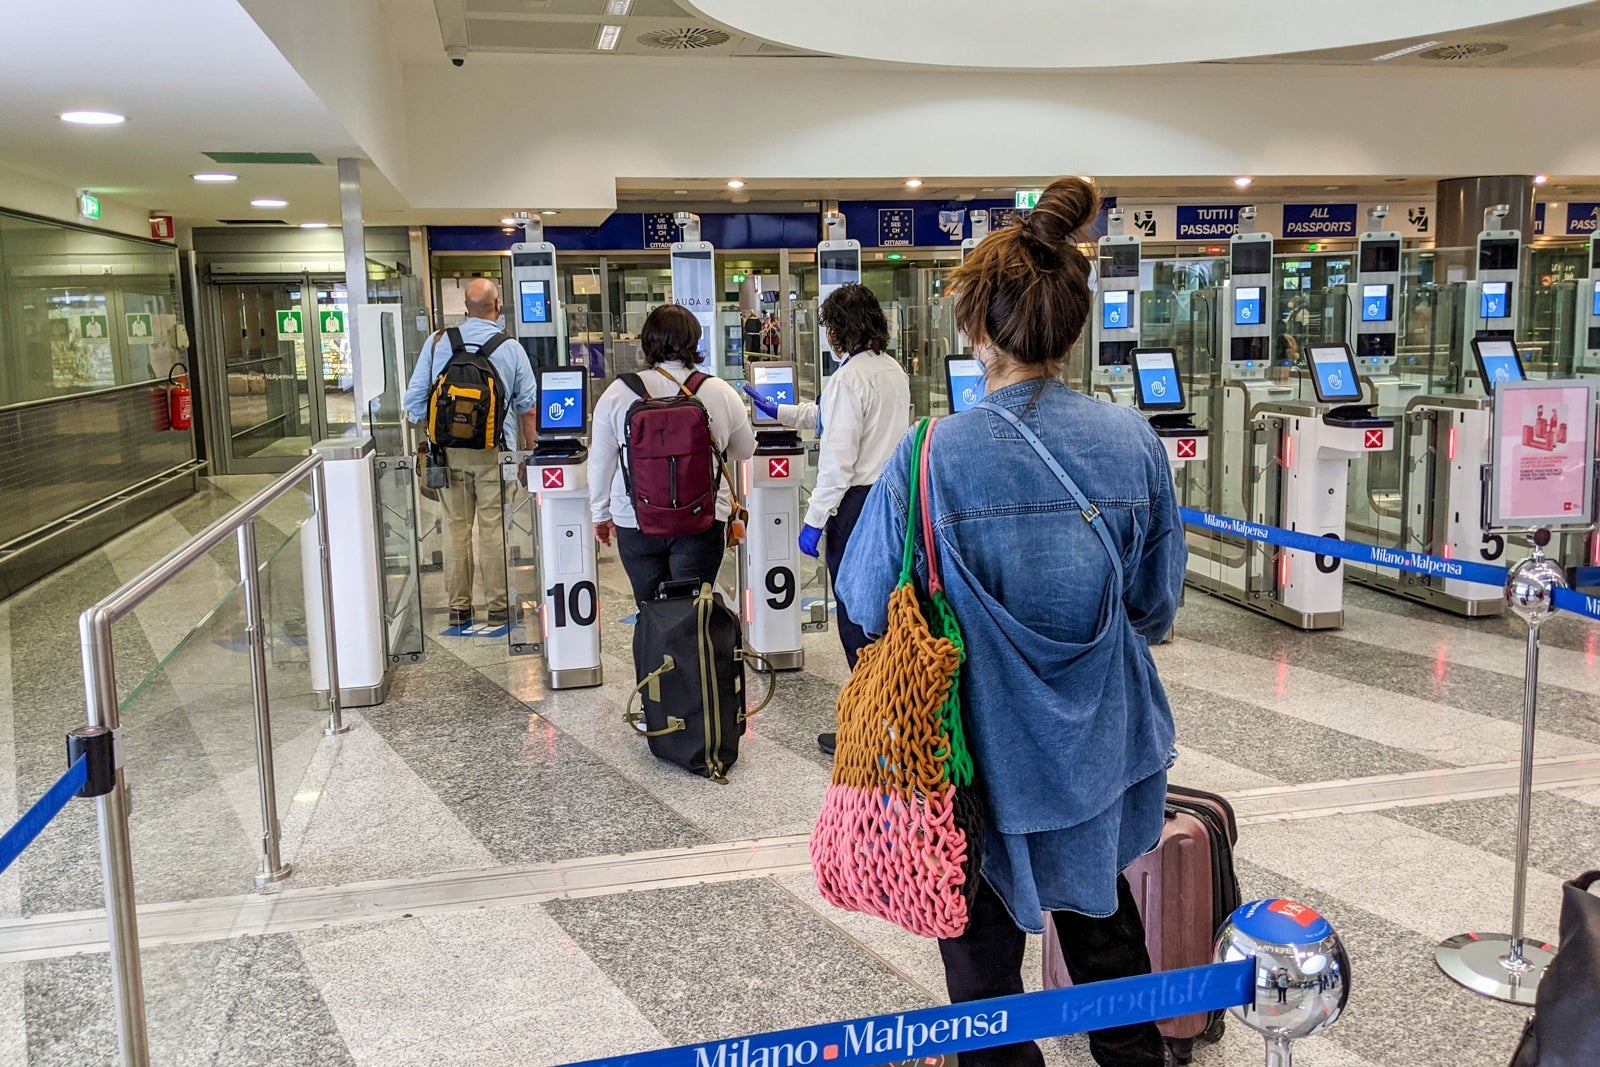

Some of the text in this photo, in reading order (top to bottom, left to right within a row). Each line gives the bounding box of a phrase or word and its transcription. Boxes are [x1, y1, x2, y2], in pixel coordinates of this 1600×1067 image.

[1197, 208, 1233, 220] TUTTI I
[1309, 207, 1330, 218] ALL
[1180, 224, 1239, 235] PASSAPOR
[1287, 221, 1352, 233] PASSPORTS
[1203, 513, 1269, 538] Milano Malpensa
[1480, 526, 1504, 561] 5
[1370, 547, 1462, 575] Milano Malpensa
[764, 566, 796, 611] 9
[546, 580, 597, 628] 10
[693, 1009, 1008, 1067] Milano Malpensa
